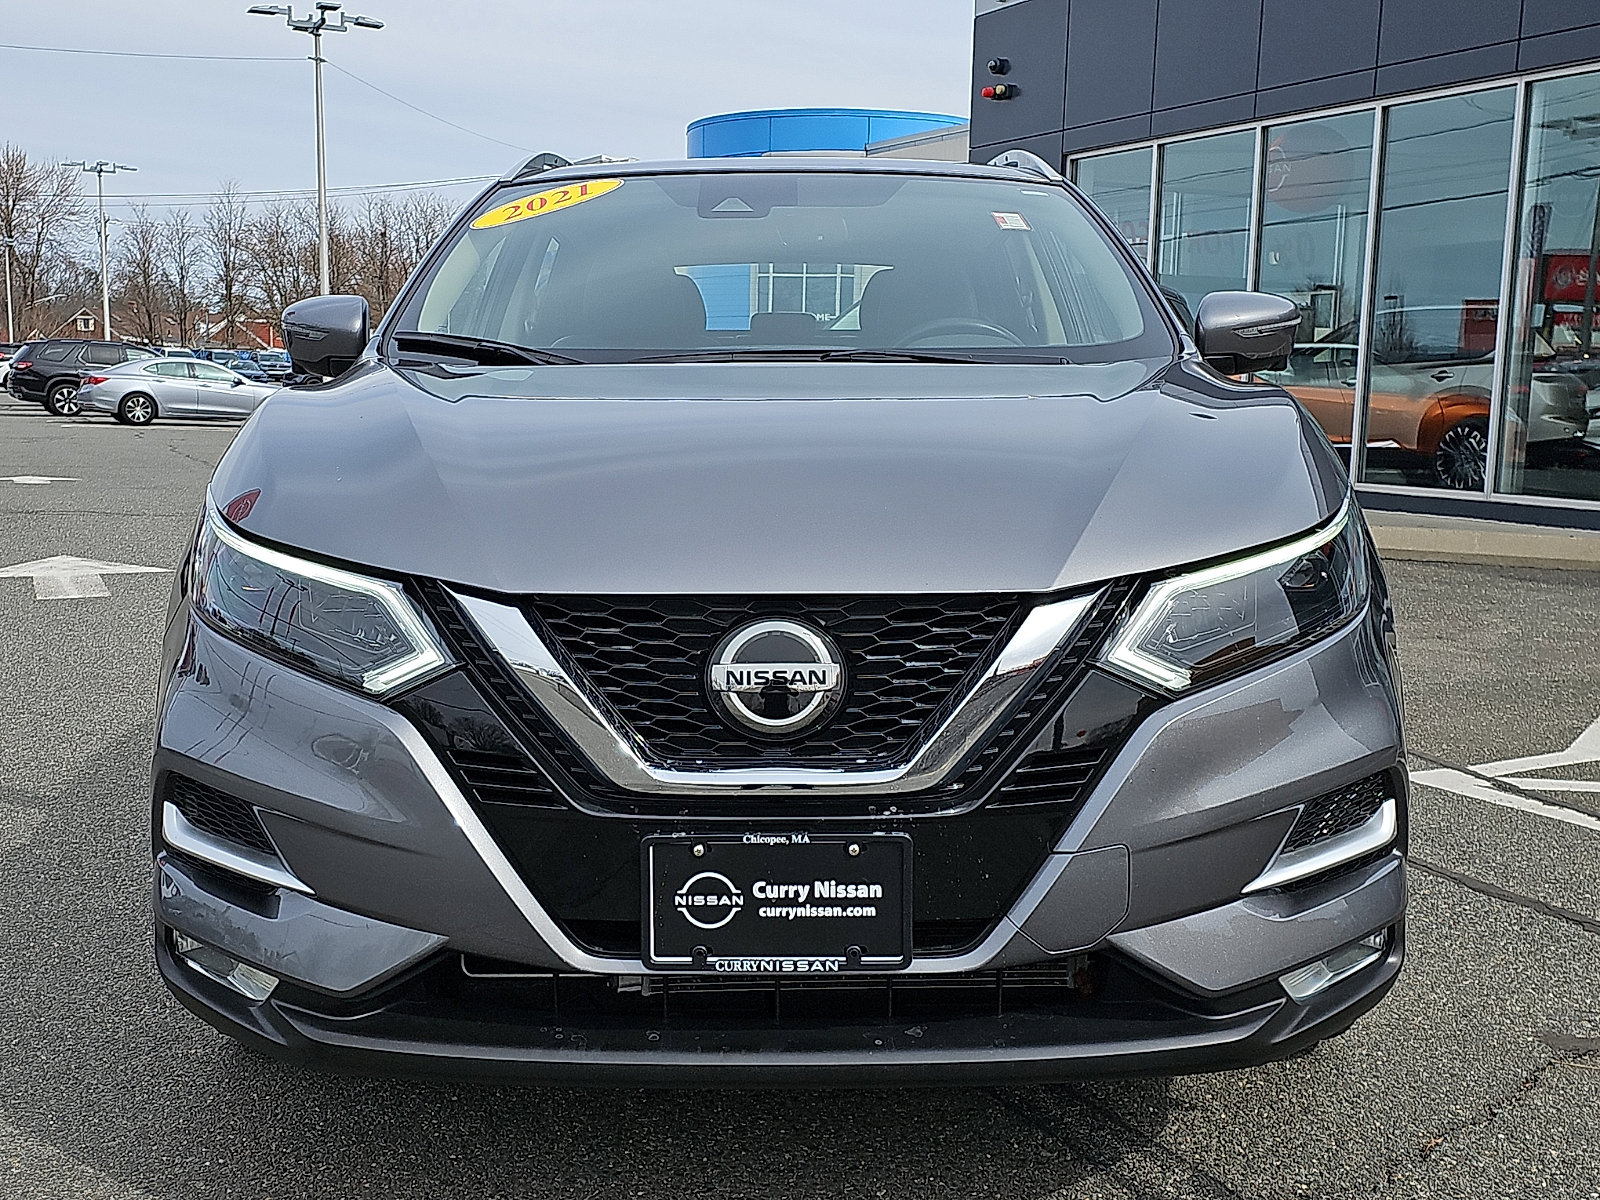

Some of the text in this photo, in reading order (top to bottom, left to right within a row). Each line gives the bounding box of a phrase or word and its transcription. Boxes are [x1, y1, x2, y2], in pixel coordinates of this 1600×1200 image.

[502, 184, 593, 221] 2021
[726, 669, 827, 686] NISSAN
[743, 834, 810, 845] Chicopee, MA
[752, 880, 882, 902] Curry Nissan
[675, 895, 744, 906] NISSAN
[759, 904, 876, 919] currynissan.com
